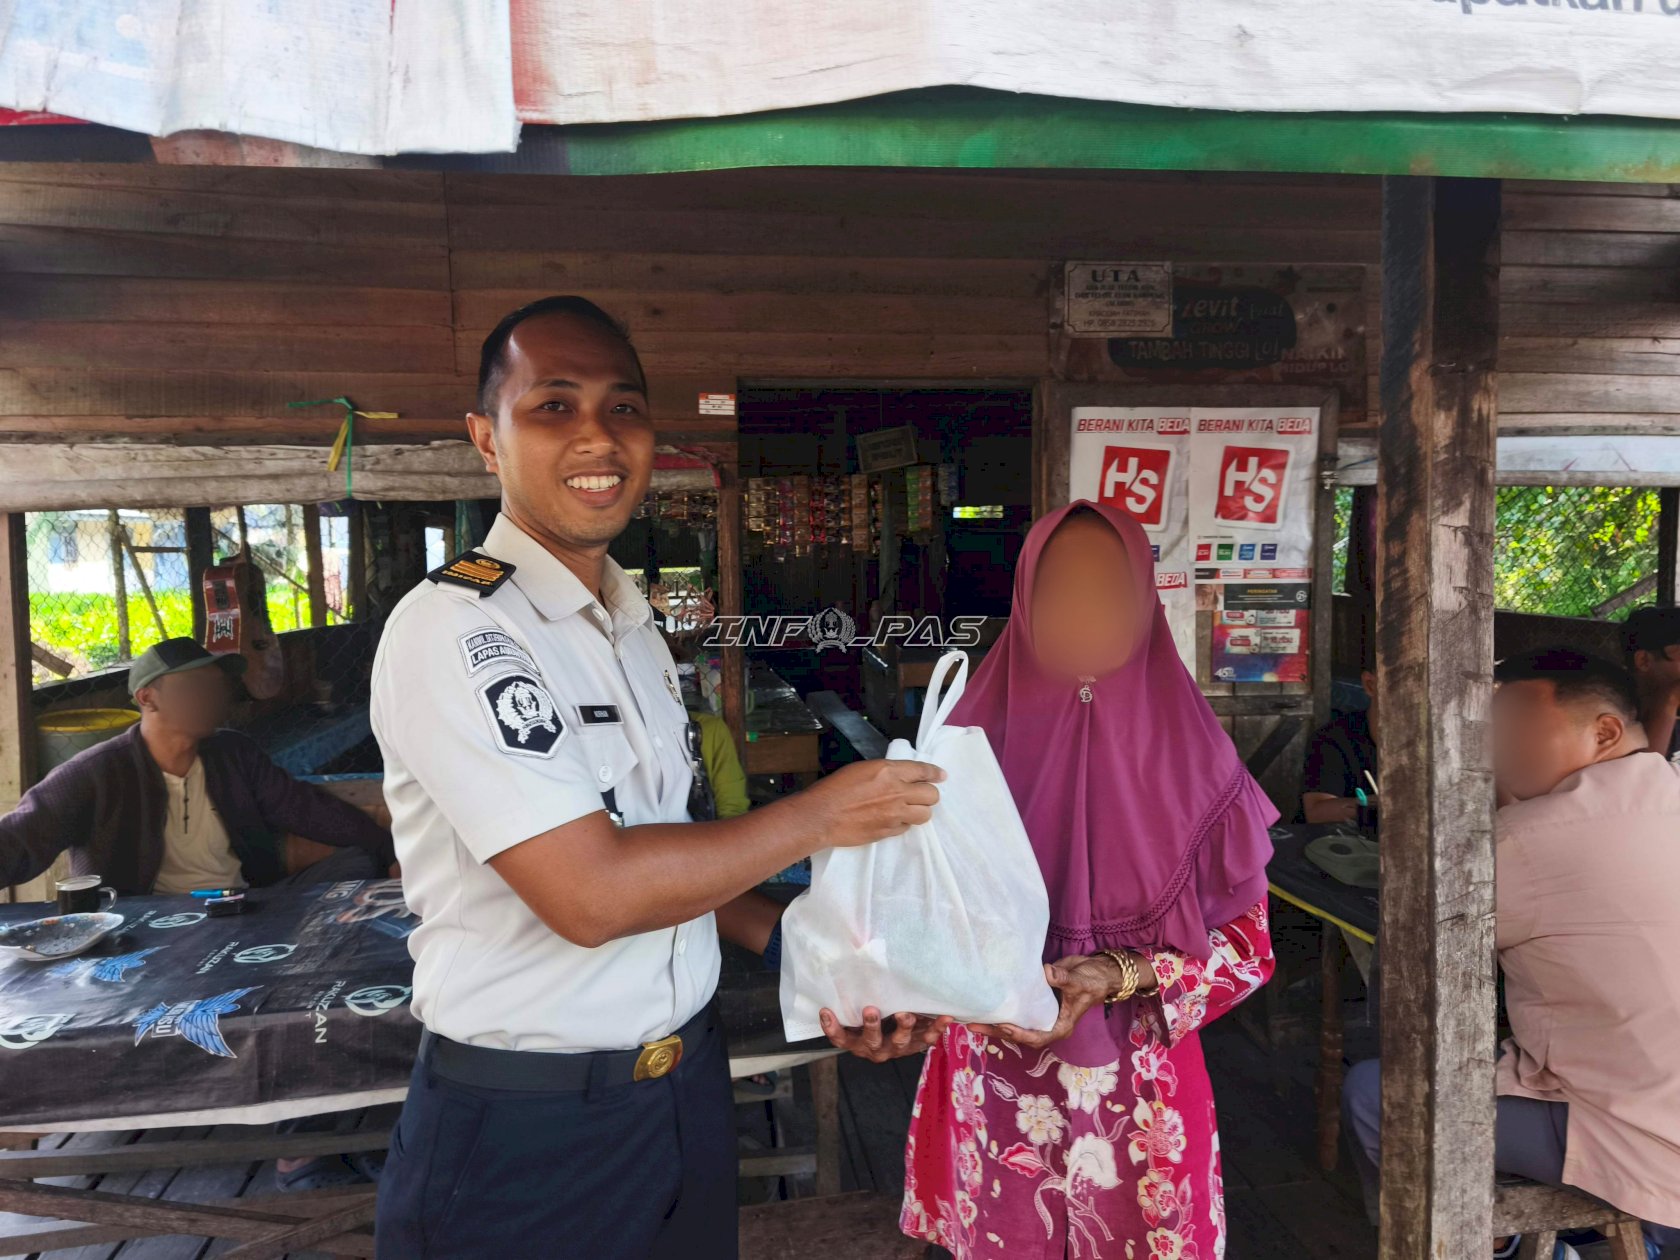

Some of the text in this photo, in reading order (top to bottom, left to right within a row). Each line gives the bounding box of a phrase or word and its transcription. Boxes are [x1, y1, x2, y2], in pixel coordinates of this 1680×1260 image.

[1092, 269, 1140, 282] UTA
[1077, 418, 1190, 432] BERANI KITA BEDA
[1198, 418, 1311, 432] BERANI KITA BEDA
[1103, 457, 1159, 513] HS
[1224, 456, 1277, 512] HS
[1156, 573, 1186, 587] BEDA
[472, 647, 500, 664] LAPAS
[313, 979, 346, 1044] RAKUZAN
